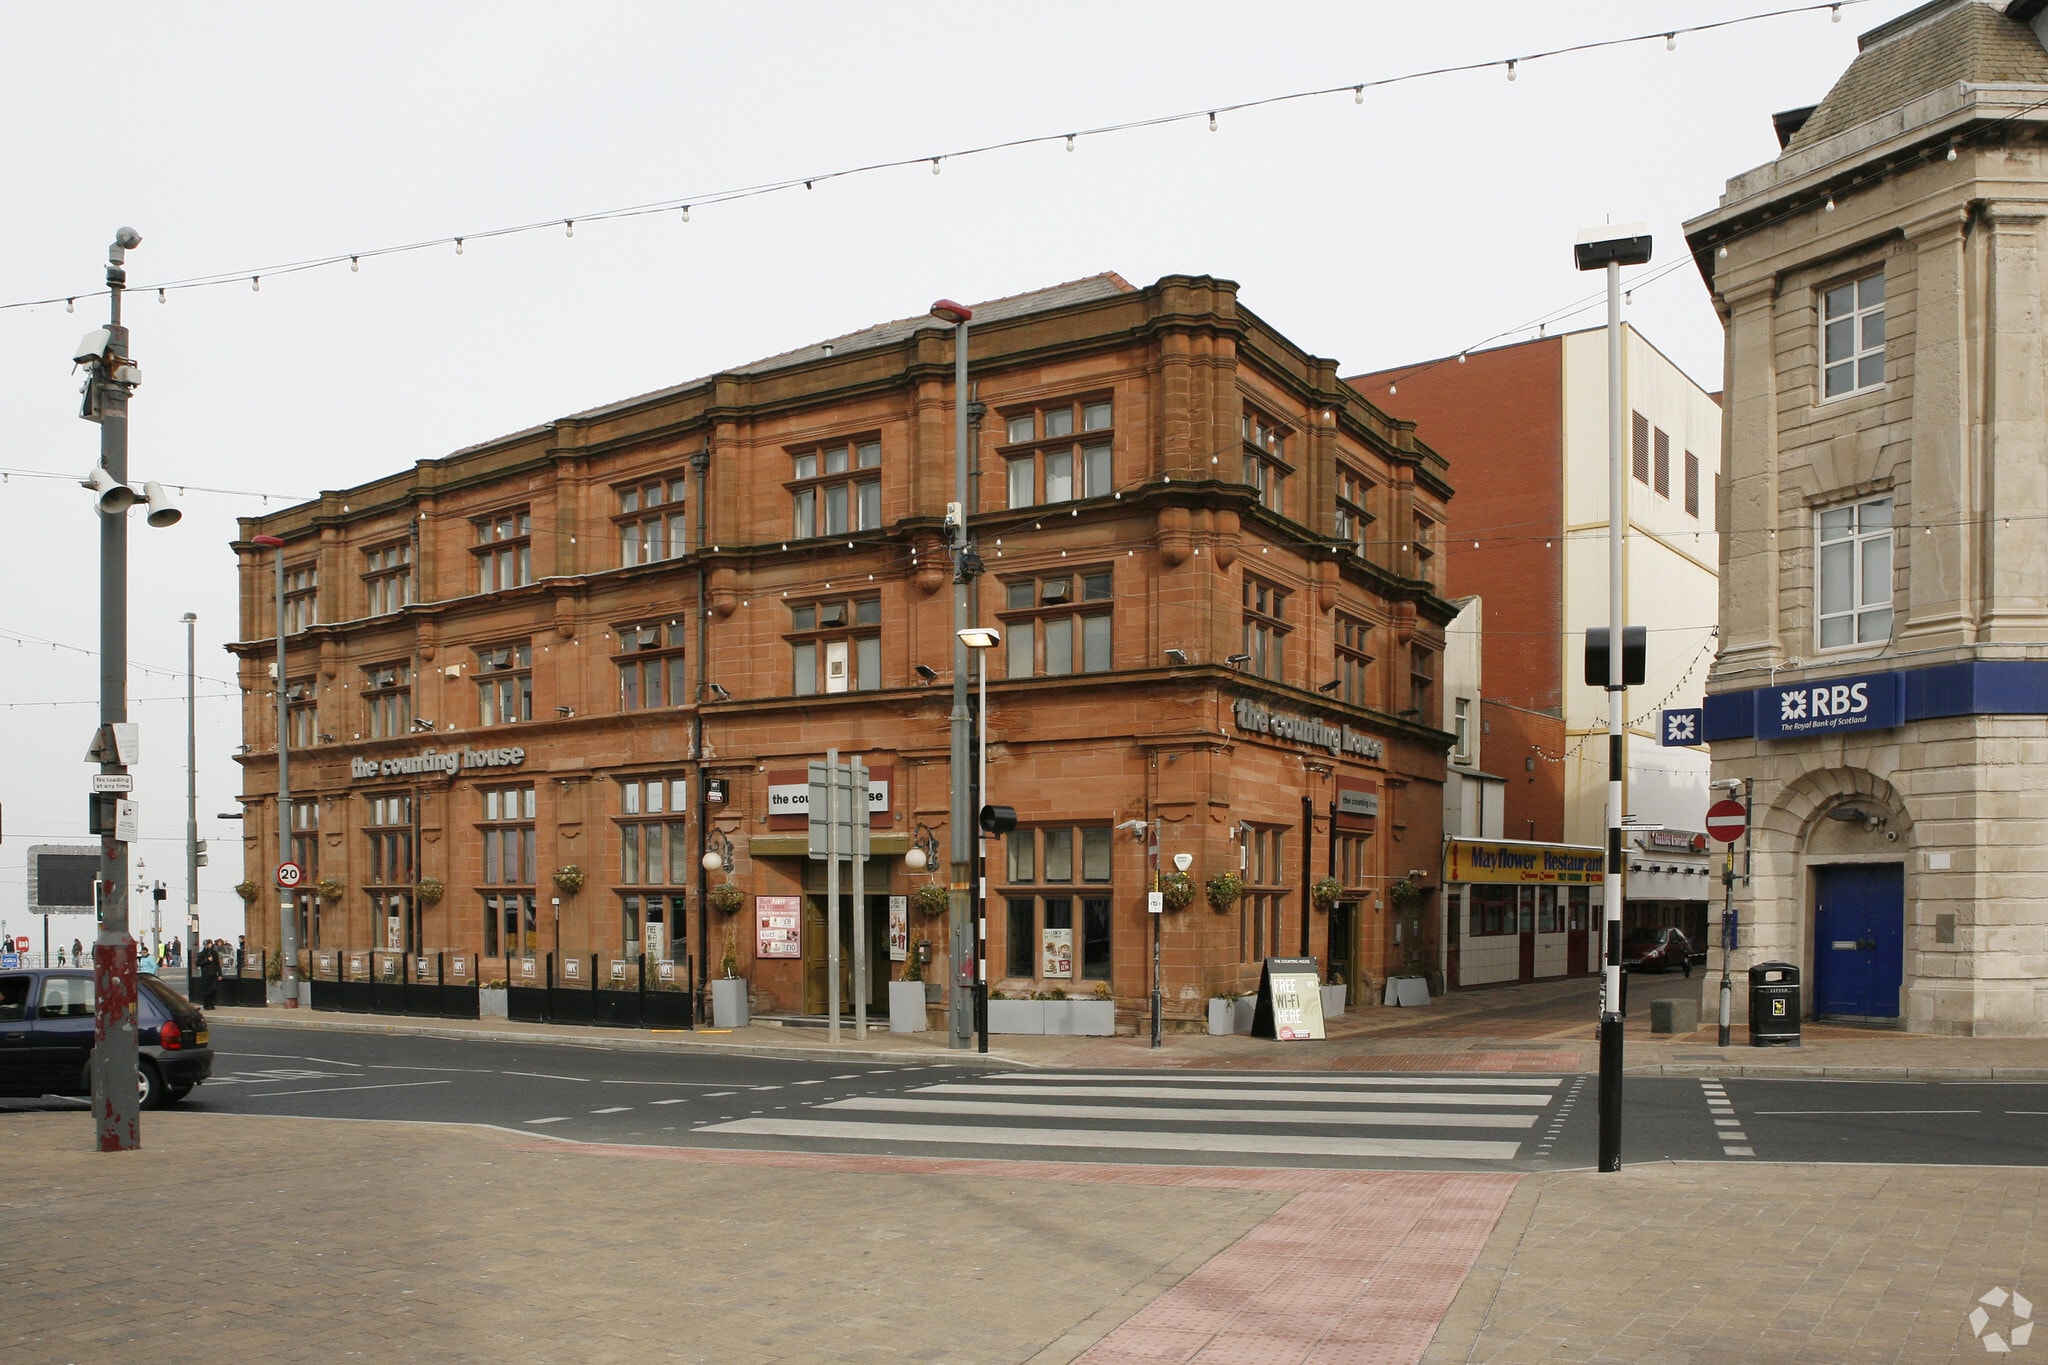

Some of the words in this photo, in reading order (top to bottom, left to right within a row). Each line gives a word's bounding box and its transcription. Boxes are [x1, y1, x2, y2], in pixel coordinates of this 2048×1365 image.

[1812, 682, 1868, 717] RBS
[1236, 698, 1269, 732] the
[1271, 713, 1341, 755] counting
[1342, 723, 1384, 758] house
[1781, 723, 1793, 731] The
[1794, 720, 1812, 732] Royal
[1812, 718, 1828, 728] Bank
[1829, 718, 1837, 729] of
[1838, 715, 1868, 726] Scotland
[351, 757, 379, 778] the
[381, 749, 460, 775] counting
[463, 745, 525, 768] house
[772, 793, 788, 805] the
[1471, 846, 1536, 874] Mayflower
[1544, 850, 1604, 872] Restaurant
[281, 868, 298, 879] 20
[1273, 978, 1297, 994] FREE
[1275, 994, 1300, 1008] WI-FI
[1277, 1009, 1302, 1024] HERE
